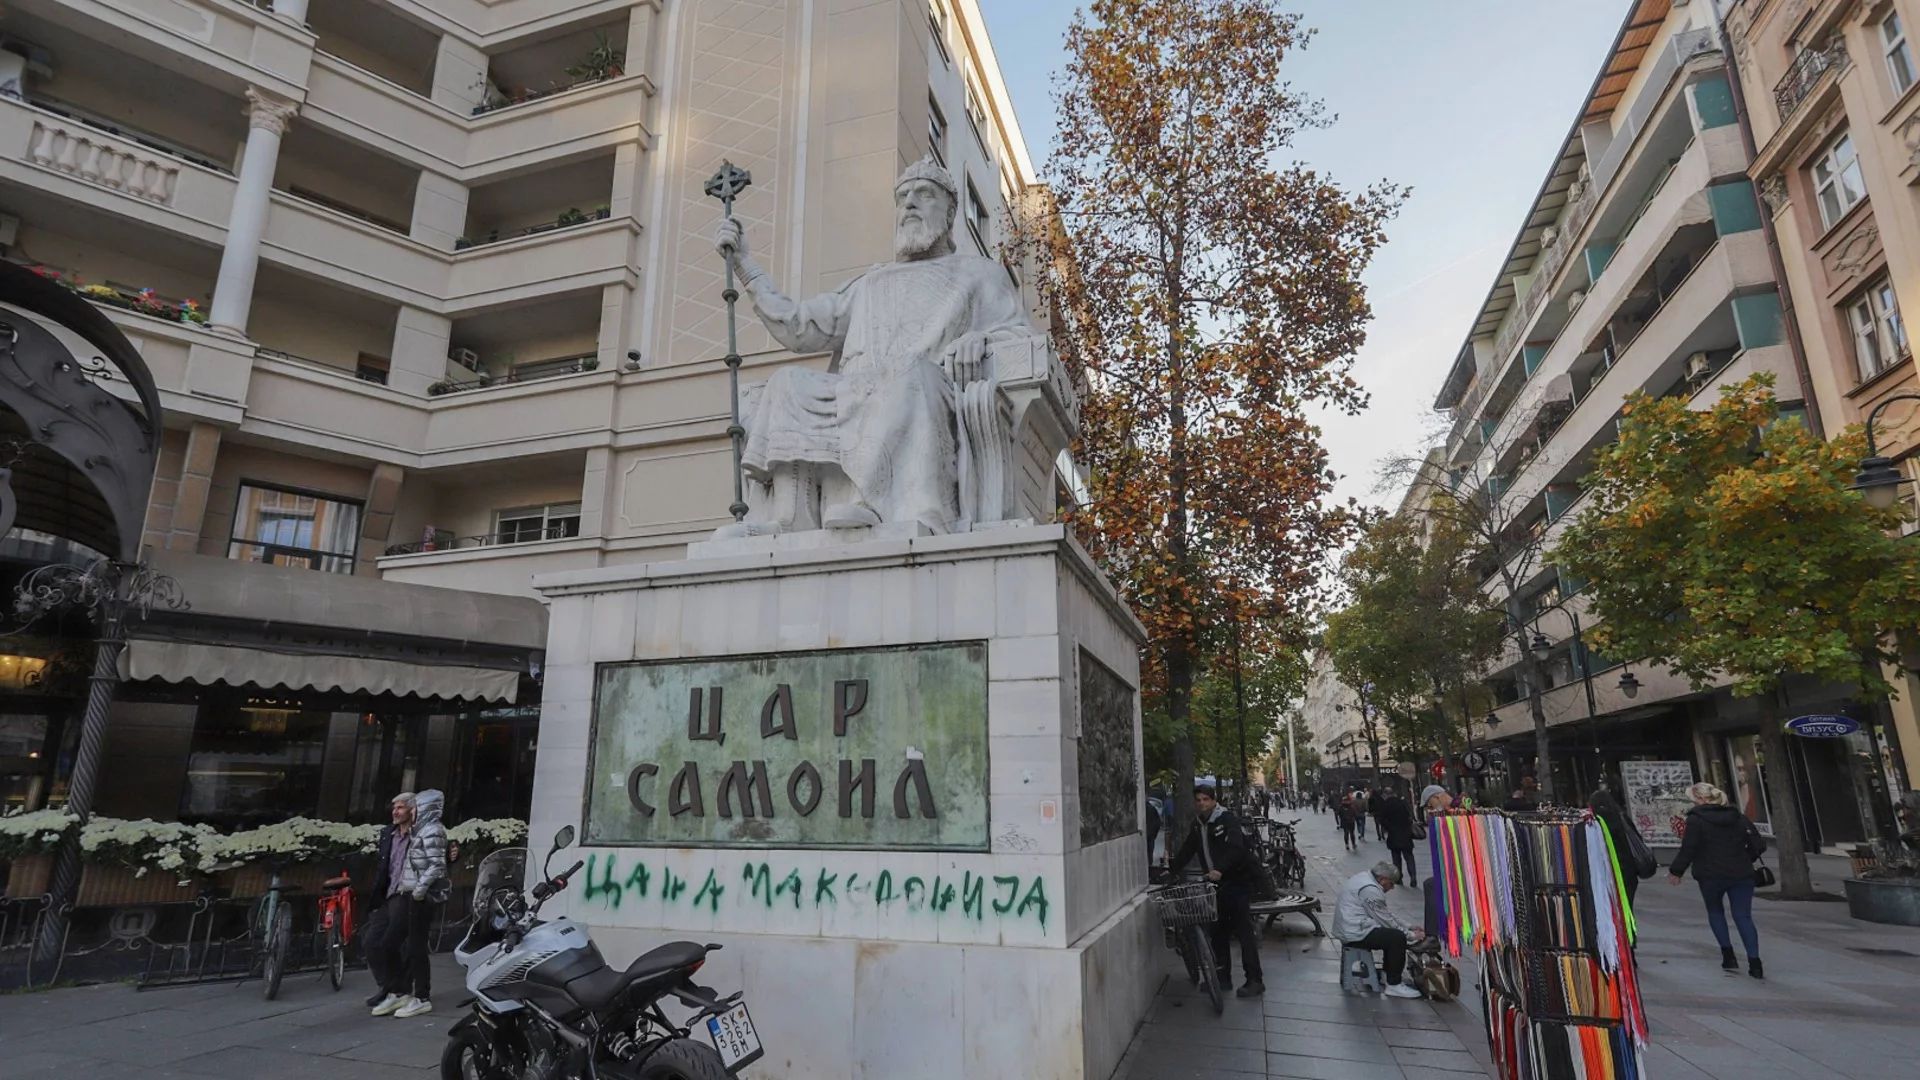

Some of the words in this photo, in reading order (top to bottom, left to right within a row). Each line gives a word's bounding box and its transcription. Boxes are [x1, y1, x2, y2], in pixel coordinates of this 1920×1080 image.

[688, 678, 869, 747] ЦАР
[627, 757, 937, 820] САМОИЛ
[718, 1021, 752, 1049] 3262
[721, 1012, 738, 1030] SK
[731, 1038, 749, 1058] BM
